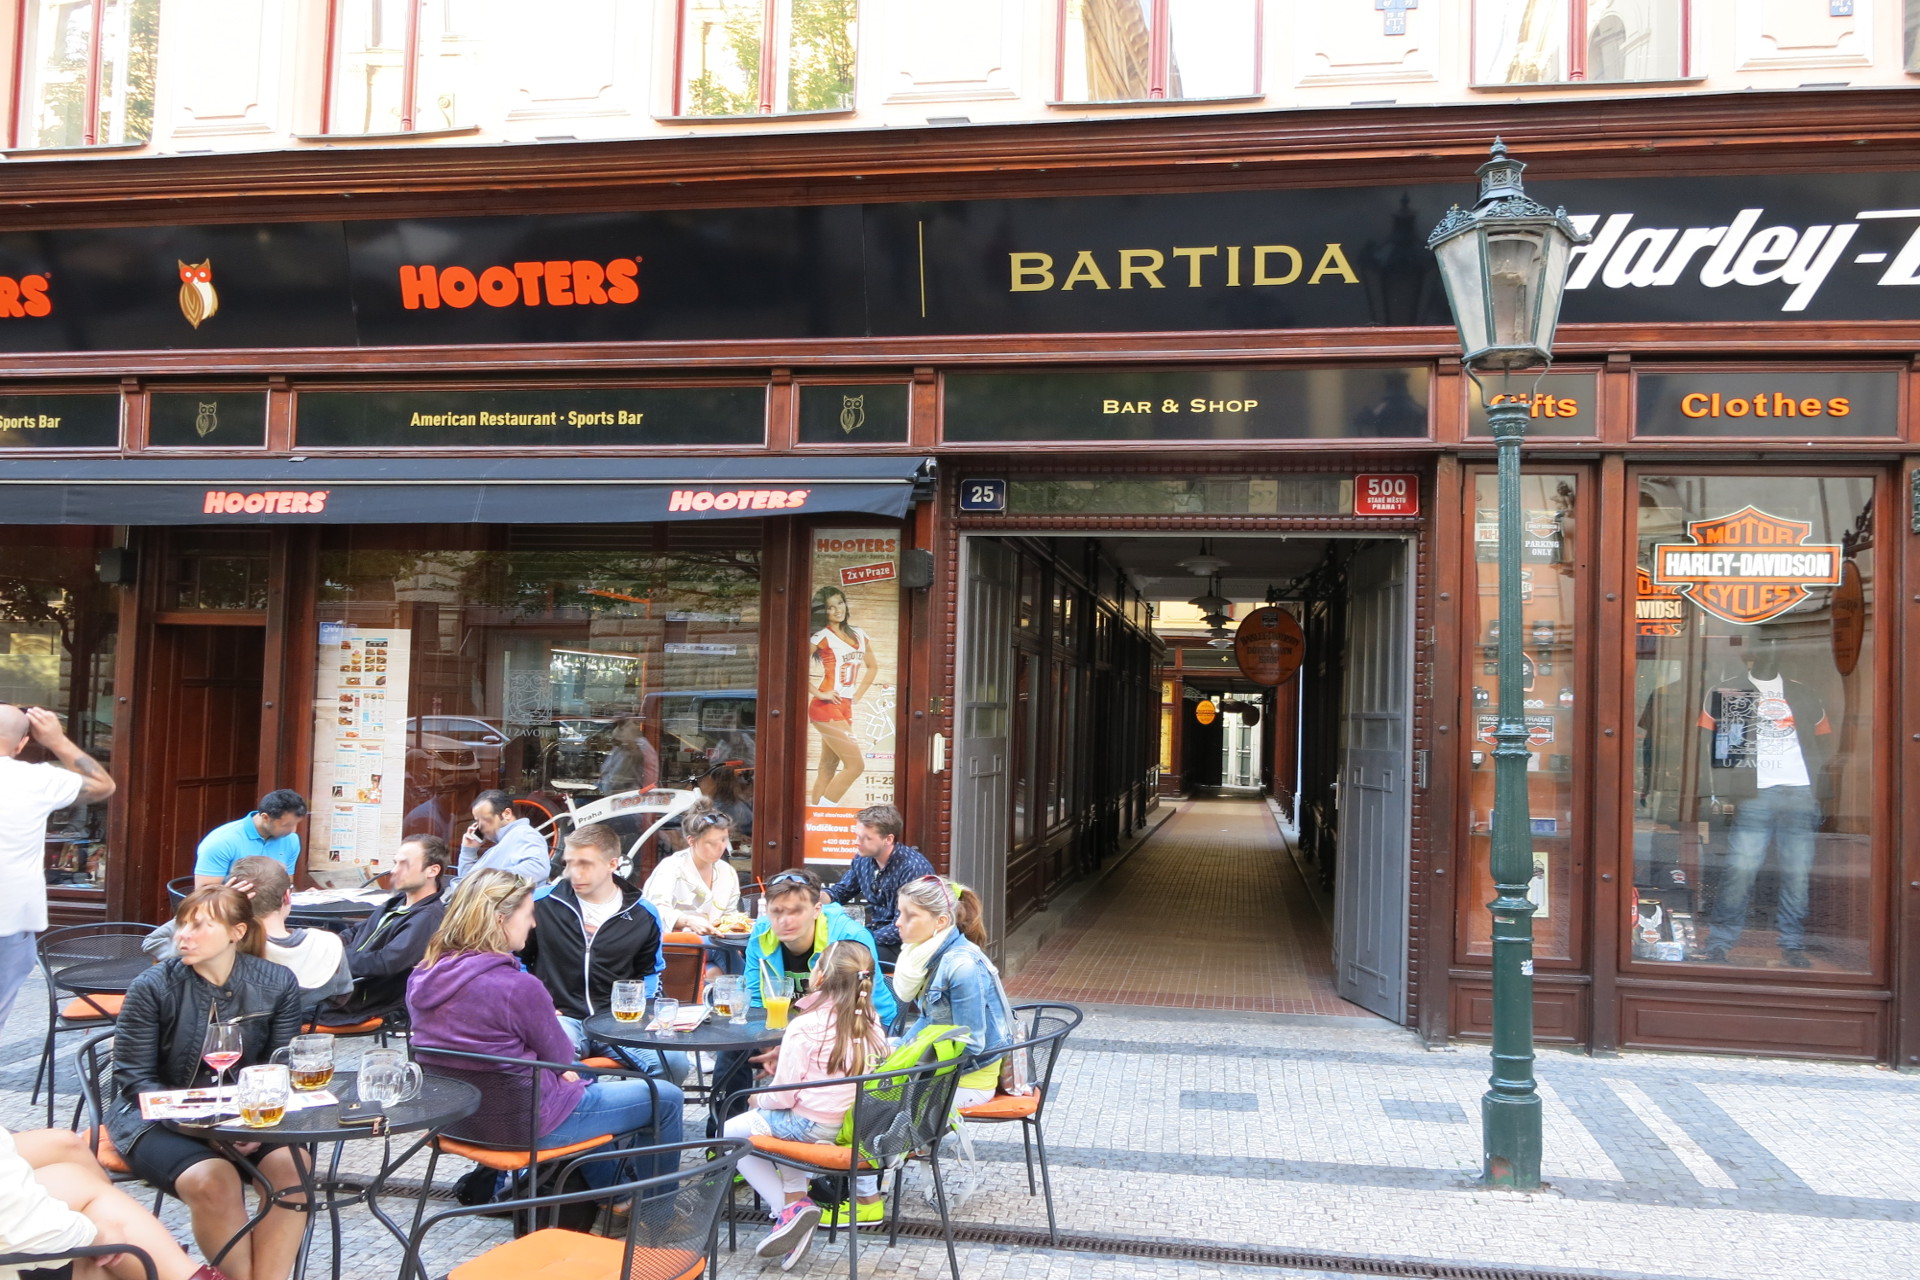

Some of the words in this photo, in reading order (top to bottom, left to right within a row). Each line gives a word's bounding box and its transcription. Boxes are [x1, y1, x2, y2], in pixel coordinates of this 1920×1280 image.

[1009, 242, 1360, 293] BARTIDA
[400, 258, 639, 310] HOOTERS
[1161, 398, 1180, 413] &
[1681, 392, 1851, 418] Clothes
[38, 414, 61, 428] Bar
[410, 411, 476, 426] American
[480, 411, 556, 426] Restaurant
[567, 411, 614, 429] Sports
[618, 410, 643, 426] Bar
[971, 486, 994, 502] 25
[1368, 479, 1406, 495] 500
[203, 491, 326, 514] HOOTERS
[668, 490, 808, 512] HOOTERS
[1706, 520, 1793, 544] MOTOR
[816, 538, 896, 553] HOOTERS
[846, 571, 858, 580] 2x
[859, 570, 865, 578] v
[865, 566, 890, 578] Praze
[1665, 552, 1831, 577] HARLEY-DAVIDSON
[1703, 585, 1791, 616] CYCLES
[1722, 759, 1732, 768] U
[578, 810, 603, 824] Praha
[806, 823, 848, 832] Vodičkova
